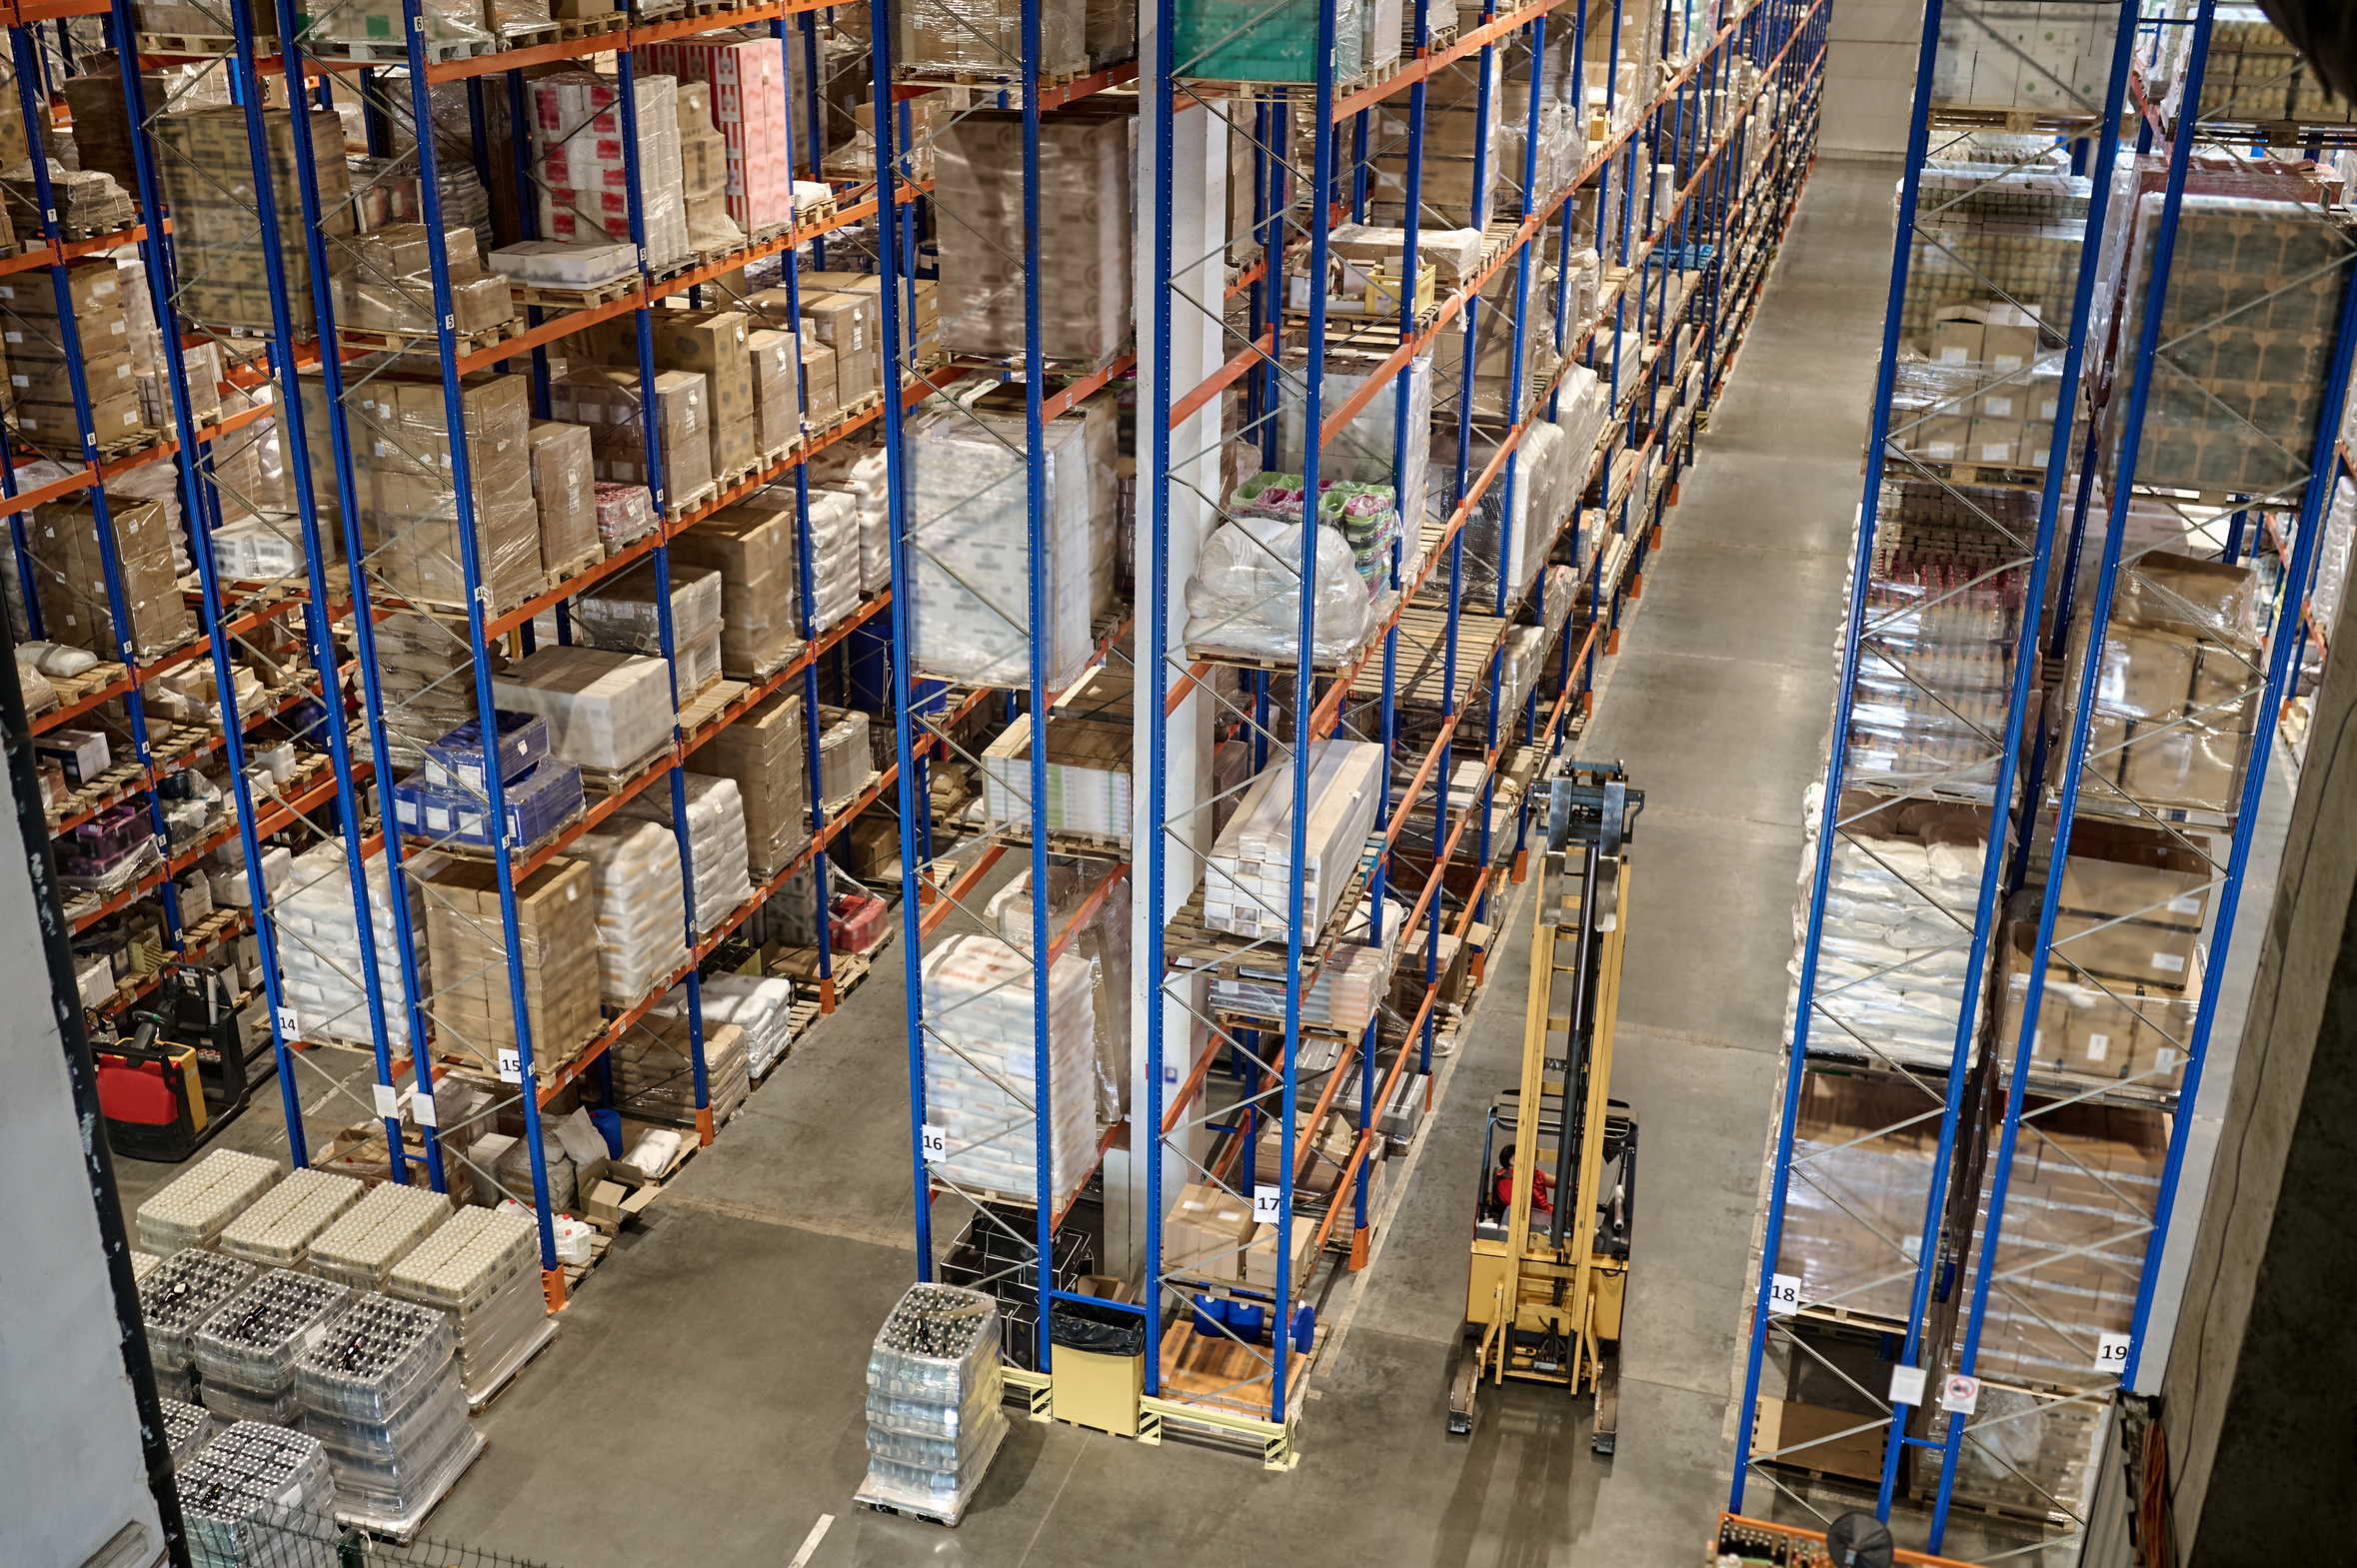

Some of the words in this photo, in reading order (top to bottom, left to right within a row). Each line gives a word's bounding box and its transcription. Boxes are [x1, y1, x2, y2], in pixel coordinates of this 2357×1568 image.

[417, 18, 422, 29] 6
[49, 211, 54, 220] 7
[642, 249, 646, 259] 5
[449, 316, 453, 327] 5
[477, 588, 481, 598] 4
[126, 643, 130, 652] 5
[504, 836, 508, 845] 3
[280, 1016, 296, 1030] 14
[502, 1059, 520, 1072] 15
[924, 1135, 943, 1150] 16
[1258, 1197, 1279, 1211] 17
[1771, 1285, 1795, 1302] 18
[2101, 1344, 2128, 1360] 19
